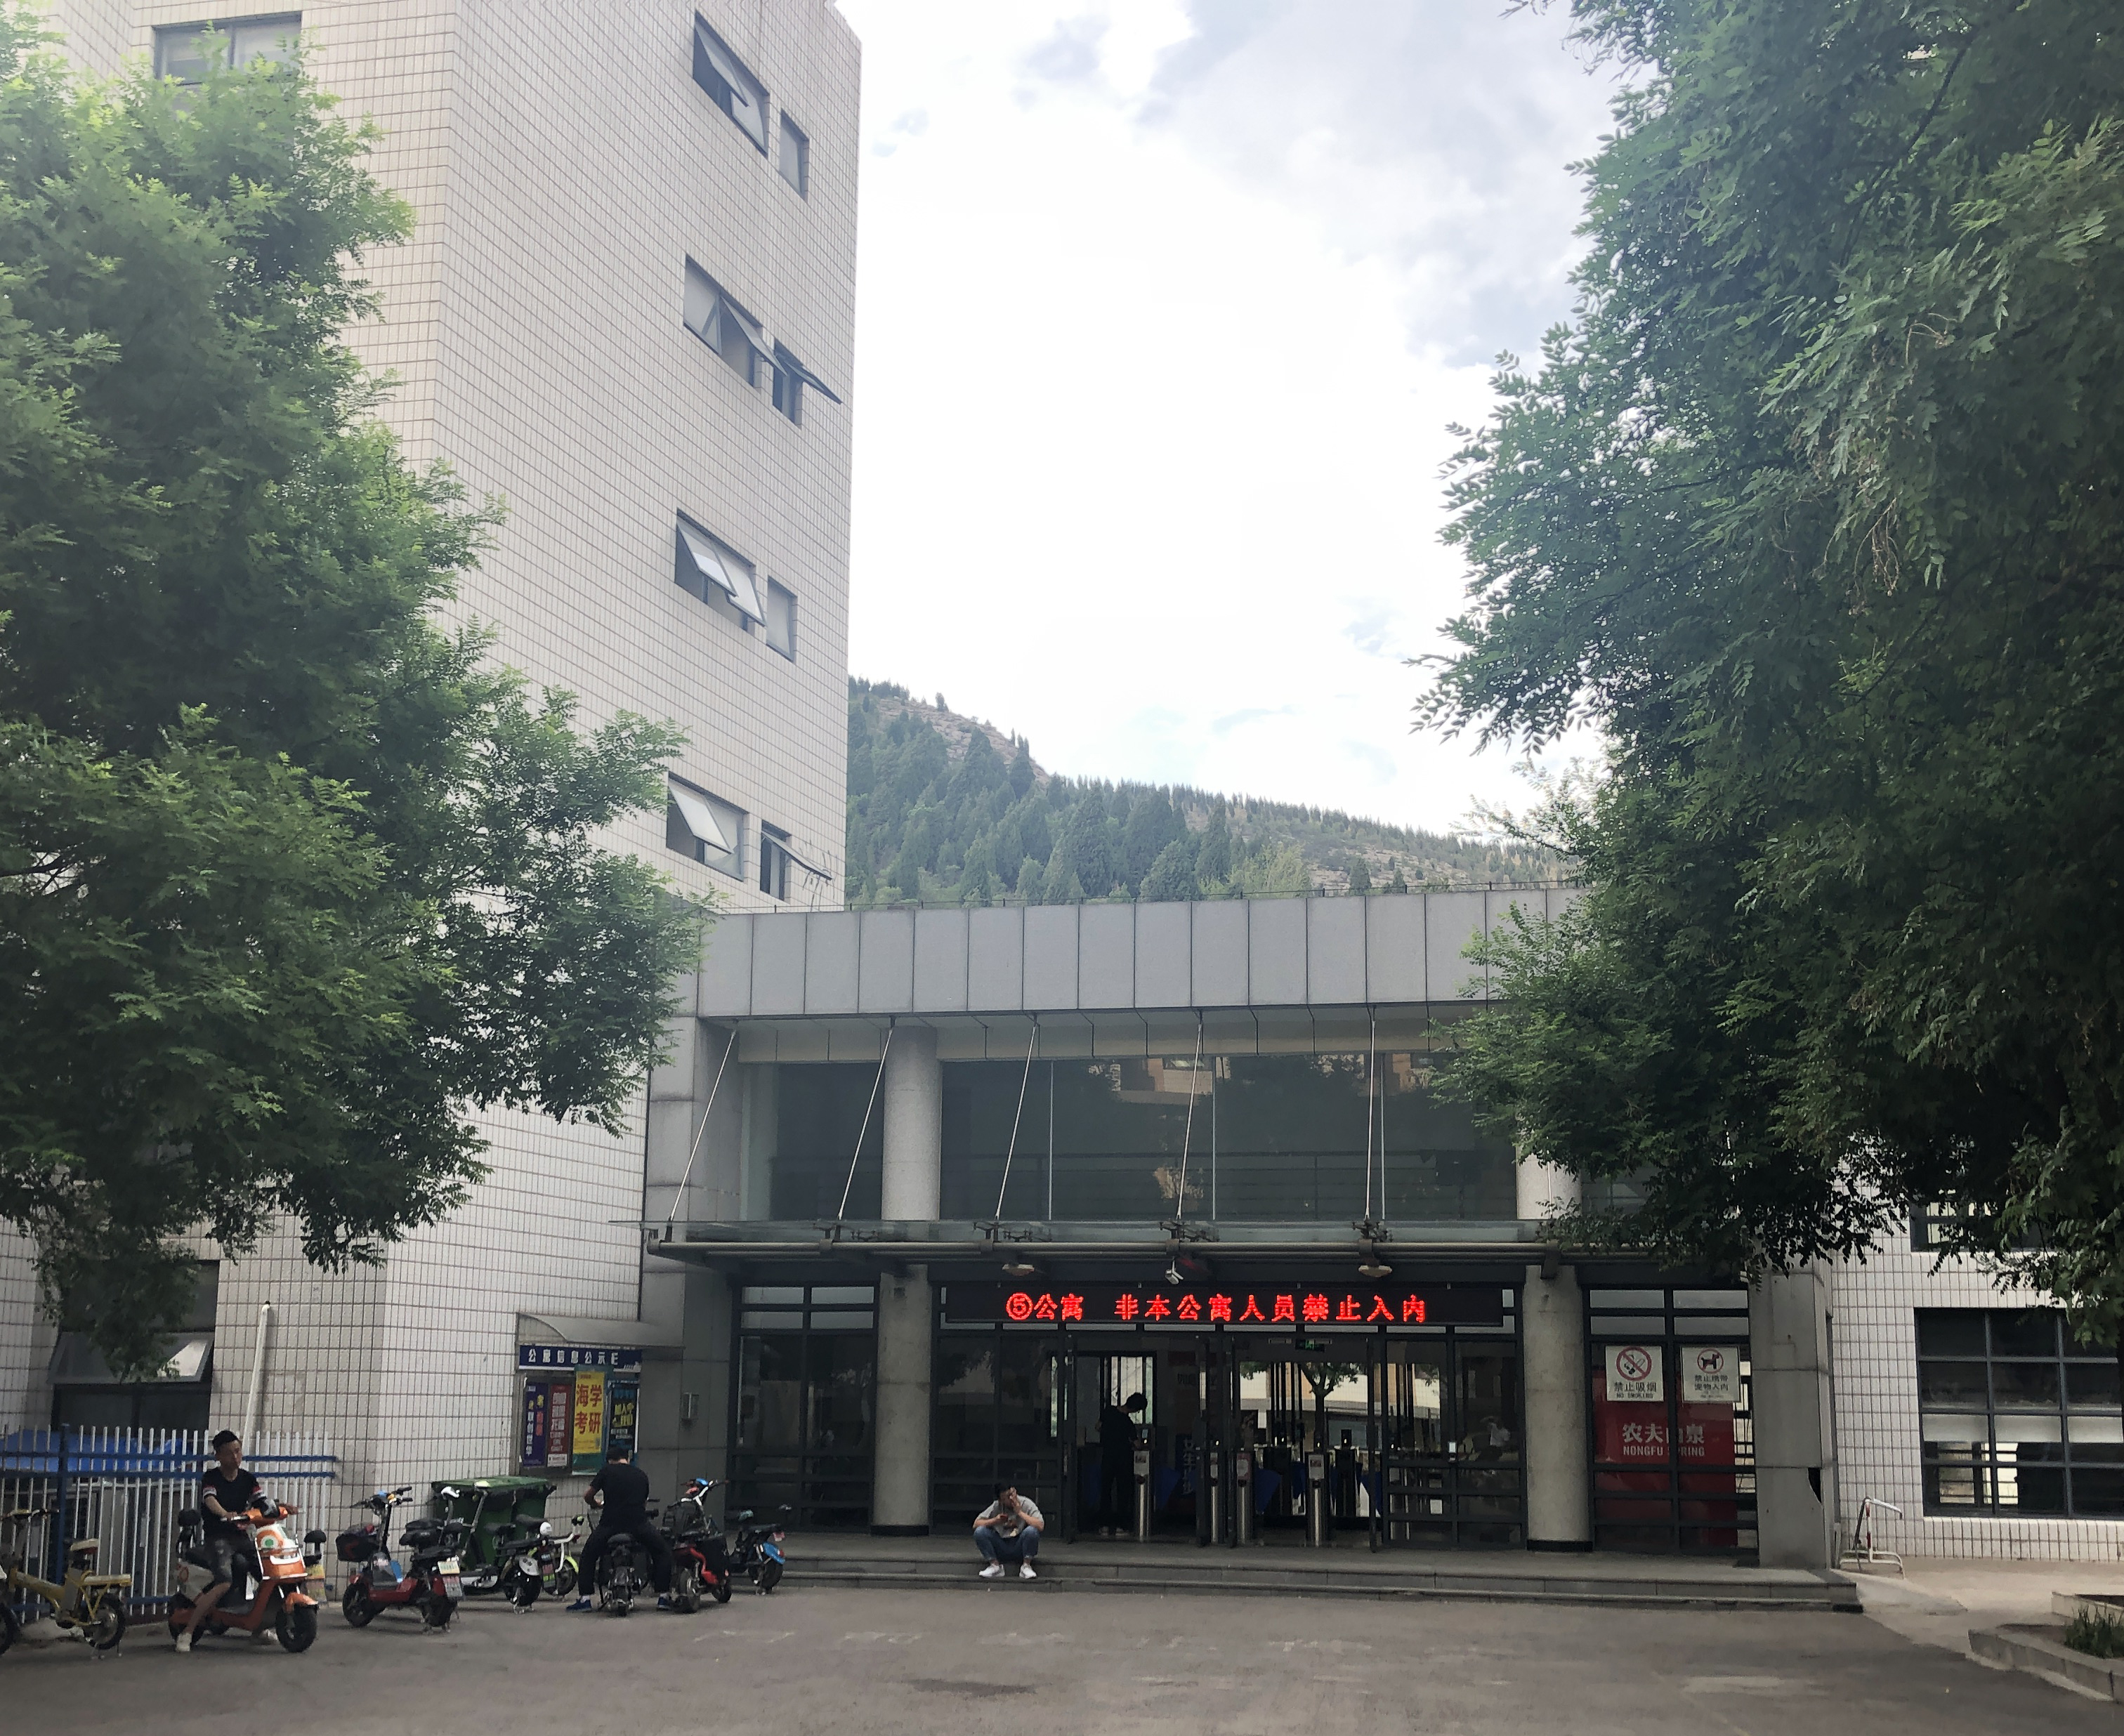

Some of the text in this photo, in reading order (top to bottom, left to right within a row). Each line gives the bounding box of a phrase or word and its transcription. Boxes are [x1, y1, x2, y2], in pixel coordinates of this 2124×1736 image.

[1114, 1293, 1427, 1324] 非本公寓人员禁止入内
[576, 1384, 602, 1407] 海学
[1613, 1381, 1657, 1393] 禁止吸烟
[575, 1412, 601, 1434] 考研
[1622, 1445, 1663, 1456] NONGFU
